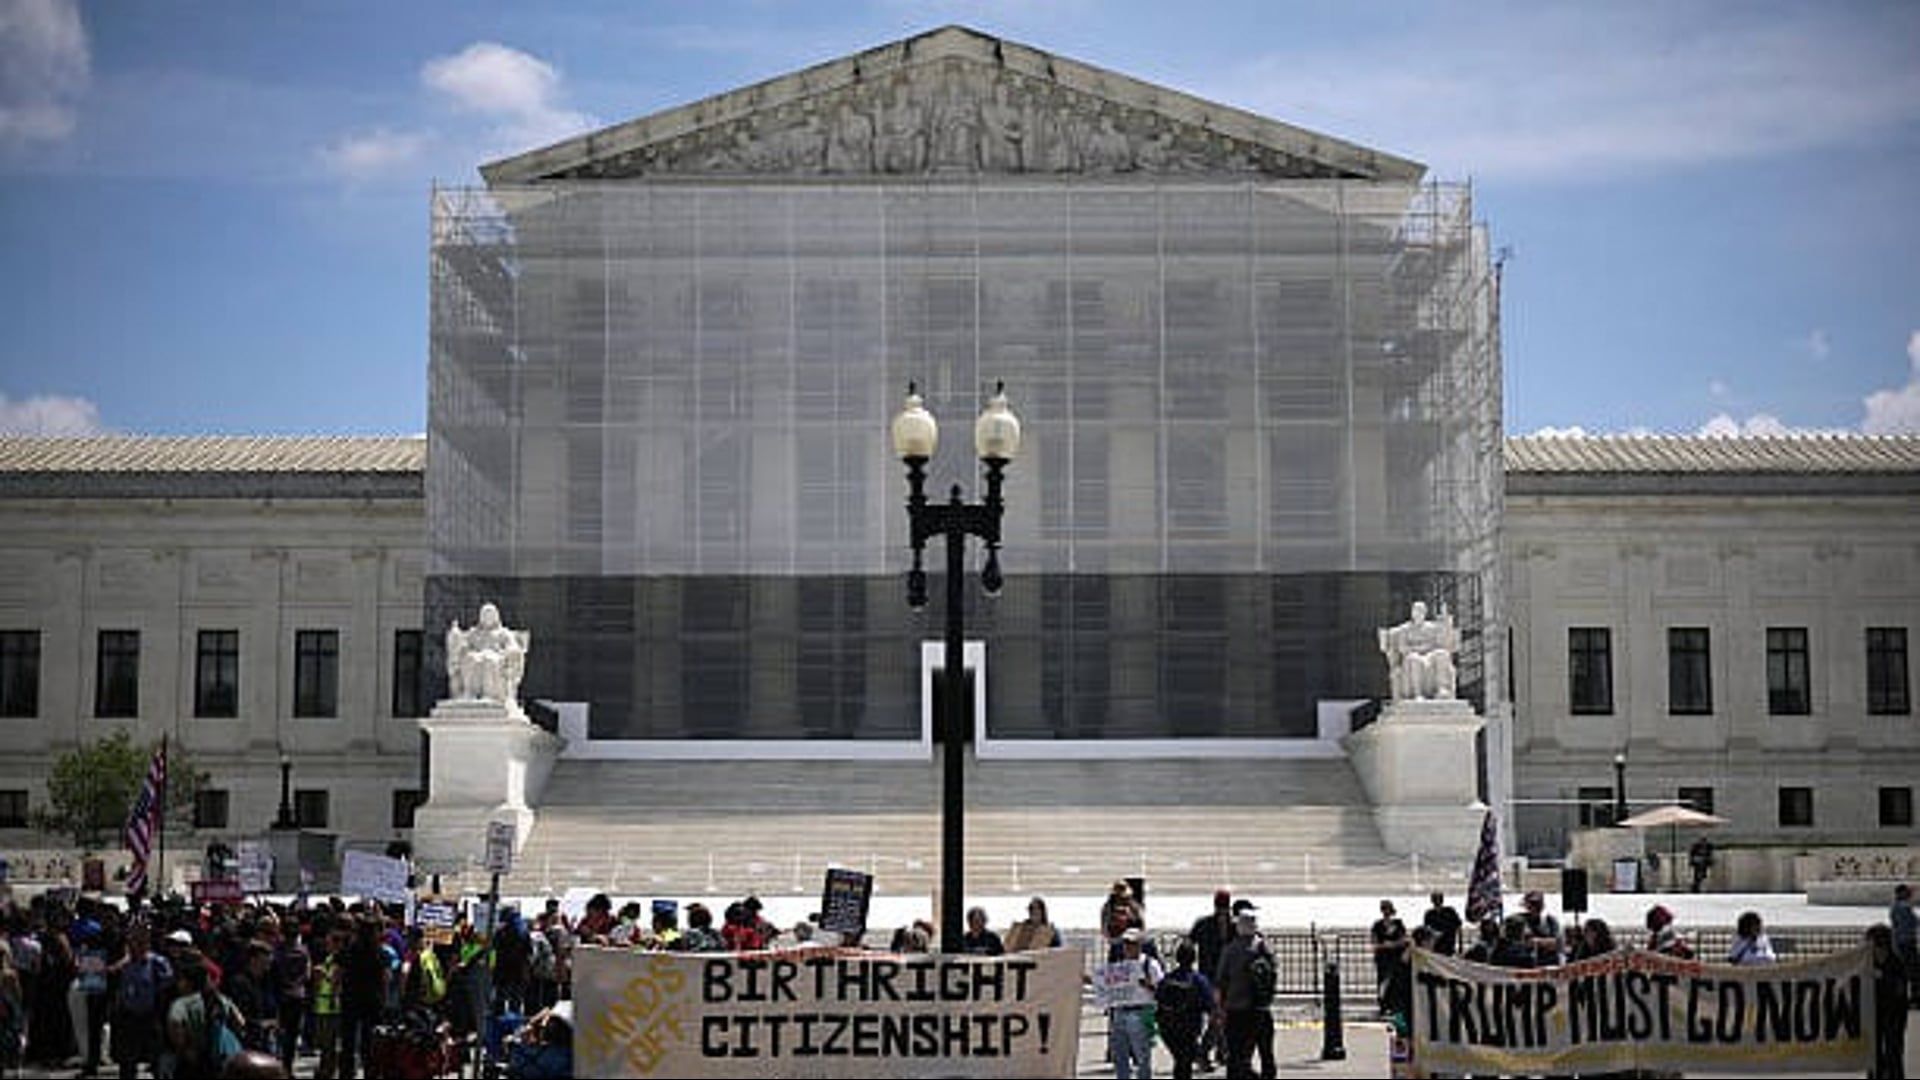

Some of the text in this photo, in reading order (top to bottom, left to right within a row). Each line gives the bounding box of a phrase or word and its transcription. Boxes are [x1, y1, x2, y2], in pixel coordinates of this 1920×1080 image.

[703, 959, 1037, 1002] BIRTHRIGHT
[1417, 970, 1862, 1048] TRUMP MUST GO NOW
[701, 1013, 1051, 1058] CITIZENSHIP!
